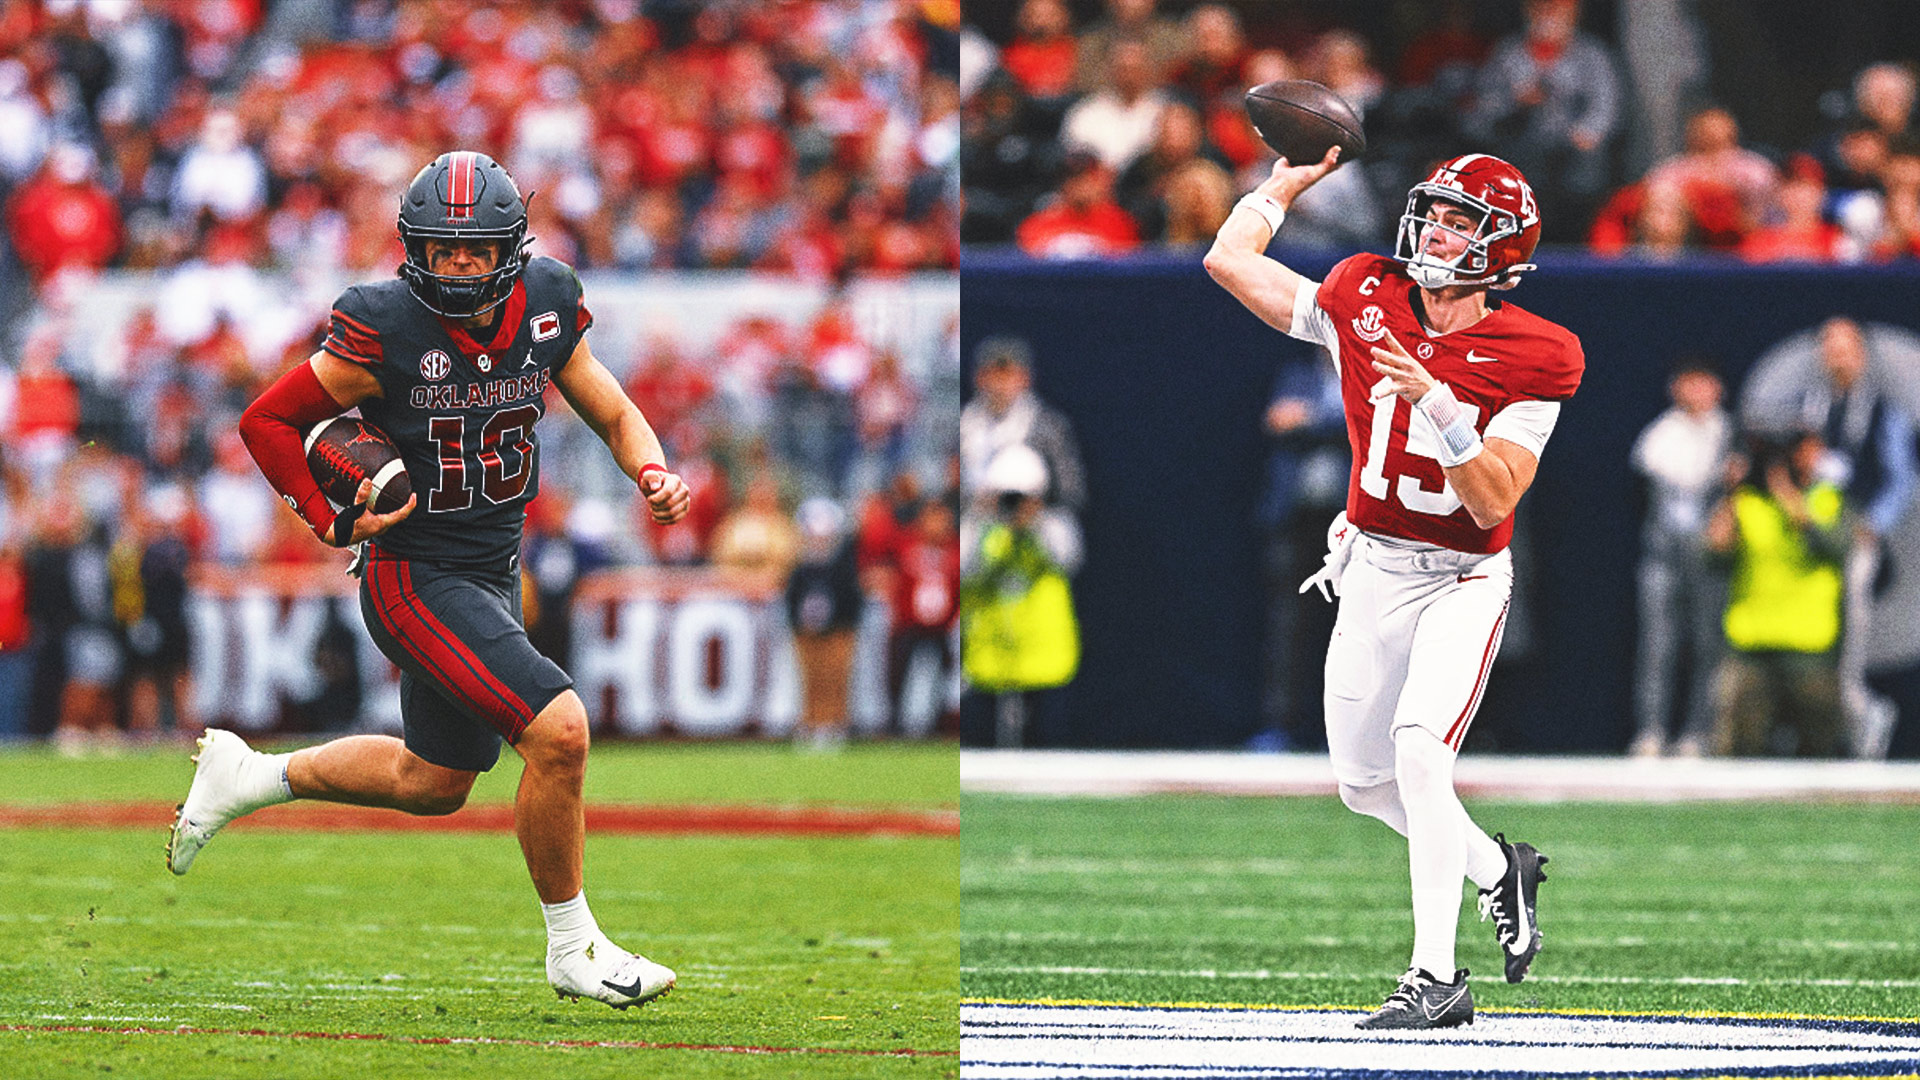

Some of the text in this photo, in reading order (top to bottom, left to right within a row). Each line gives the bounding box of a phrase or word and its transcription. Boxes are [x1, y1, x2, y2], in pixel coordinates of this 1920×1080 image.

[1358, 276, 1381, 296] C
[532, 314, 559, 340] C
[422, 352, 449, 379] SEC
[477, 353, 492, 373] OU
[410, 367, 550, 409] OKLAHOMA
[428, 403, 541, 513] 10
[1360, 375, 1481, 516] 15
